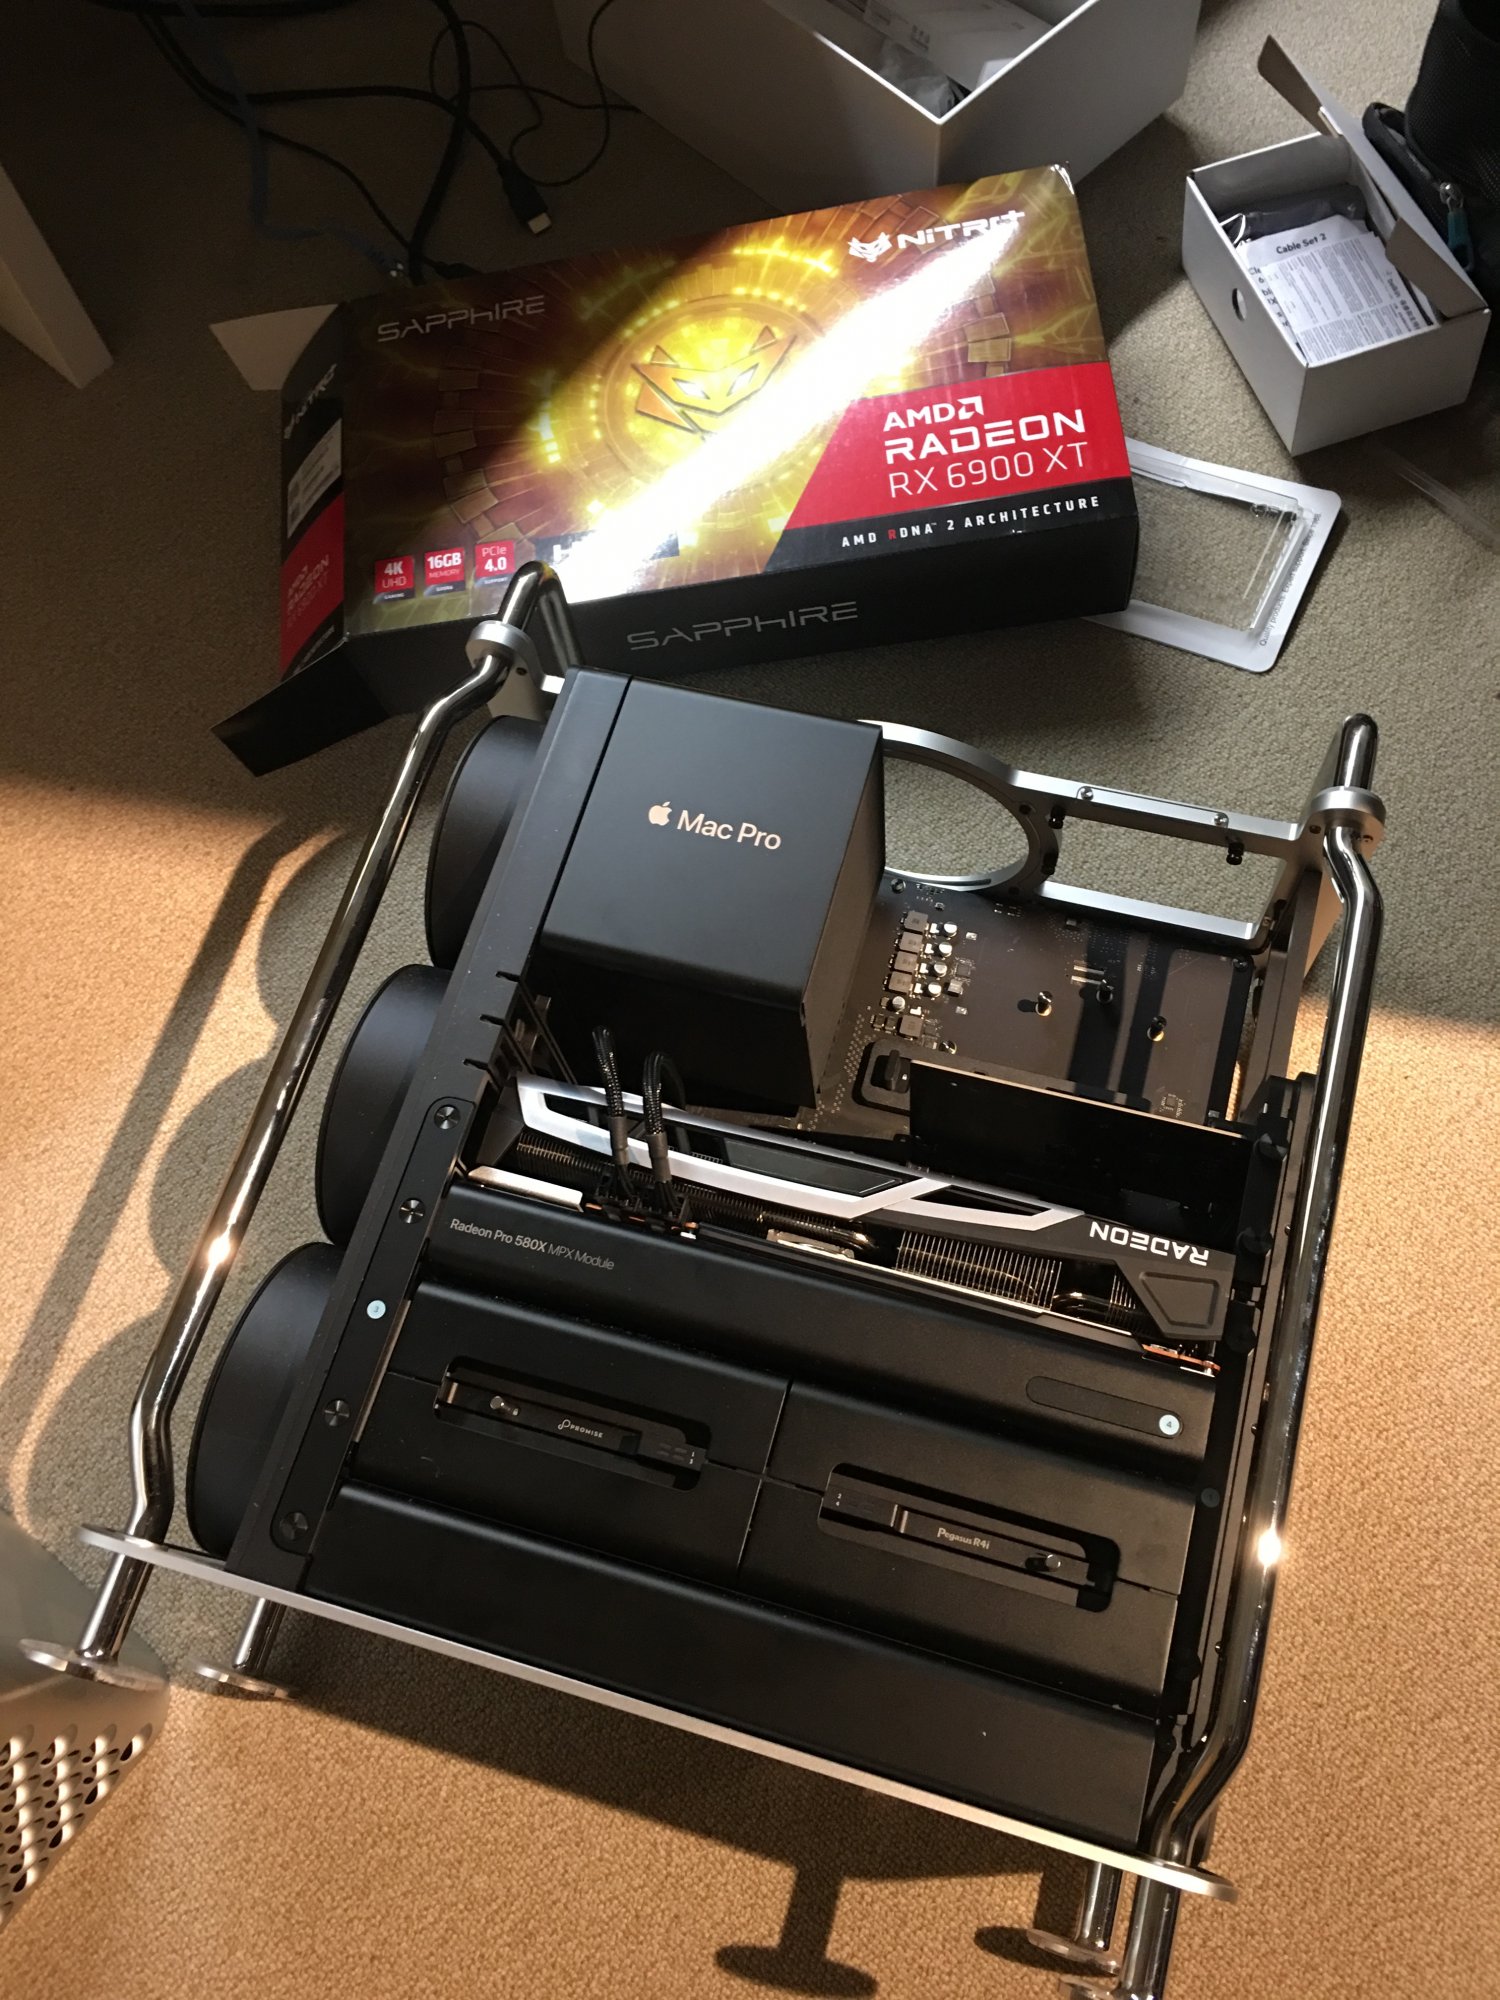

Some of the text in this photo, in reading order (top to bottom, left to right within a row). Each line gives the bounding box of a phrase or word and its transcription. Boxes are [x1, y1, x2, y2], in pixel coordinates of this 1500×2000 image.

[1276, 232, 1327, 254] Cable Set 2
[377, 295, 545, 342] SAPPHIRE
[883, 403, 956, 432] AMD
[884, 408, 1086, 465] RADEON
[888, 441, 1088, 498] RX 6900 XT
[841, 532, 877, 548] AMD
[947, 519, 956, 531] 2
[964, 496, 1099, 528] ARCHITECTURE
[427, 552, 462, 570] 16GB
[481, 546, 507, 558] PCIe
[484, 556, 507, 572] 4.0
[384, 561, 403, 576] 4K
[428, 569, 460, 579] MEMORY
[382, 576, 407, 589] UHD
[627, 601, 858, 650] SAPPHIRE
[677, 809, 782, 850] Mac Pro
[450, 1218, 615, 1270] Radeon Pro 580X MPX Module
[1089, 1221, 1209, 1267] RADEON
[570, 1424, 604, 1439] PROMISE
[937, 1527, 990, 1550] Pegasus R4i
